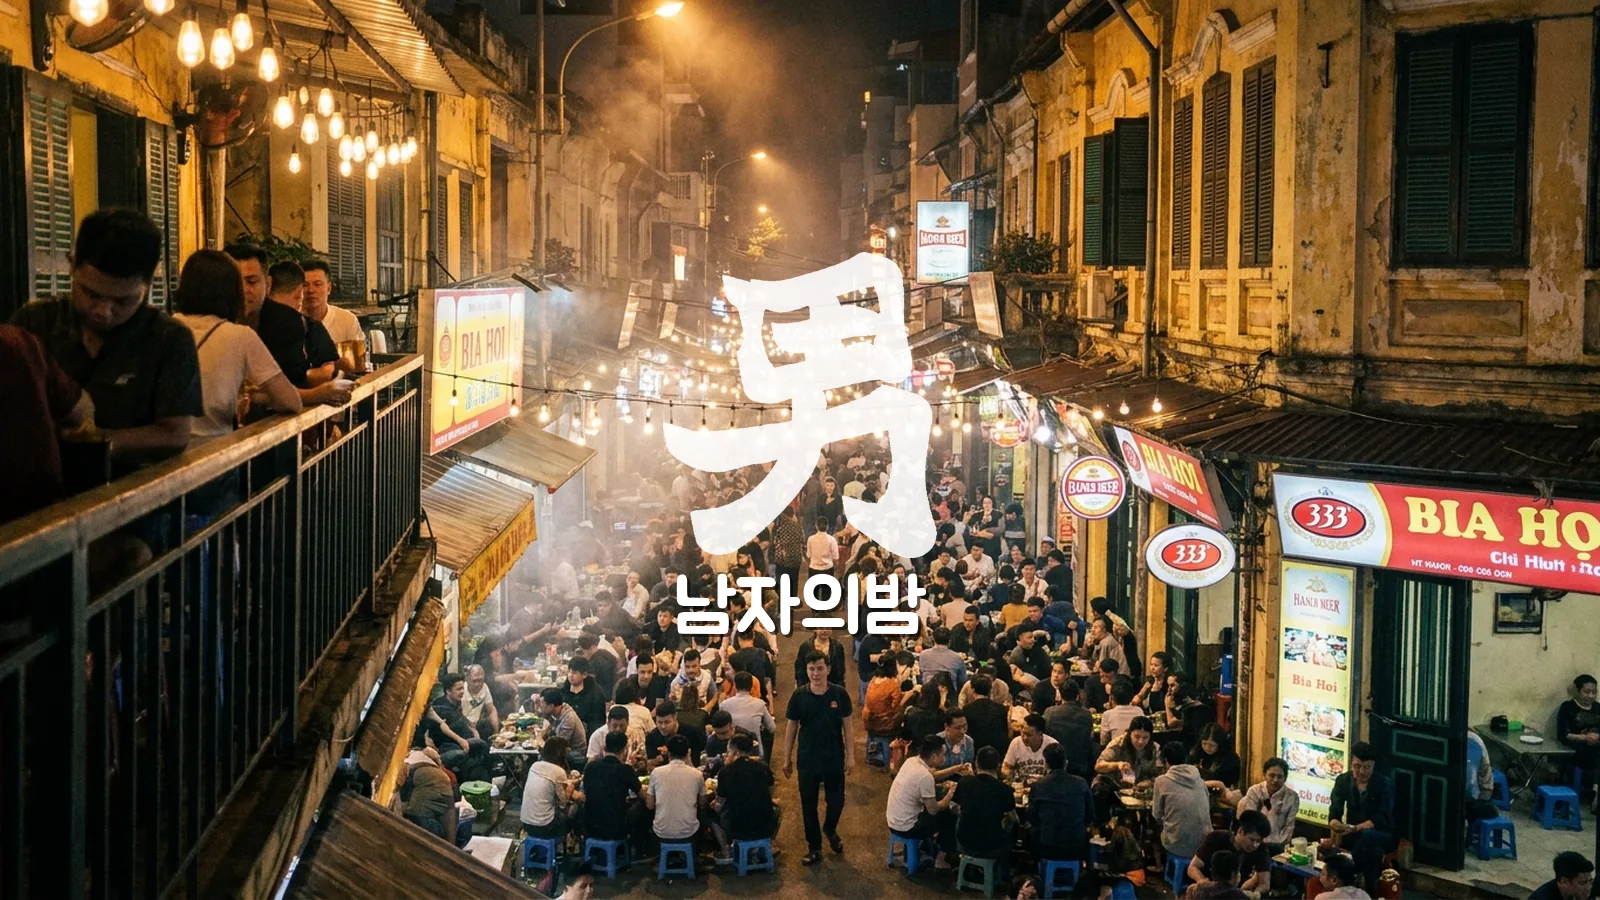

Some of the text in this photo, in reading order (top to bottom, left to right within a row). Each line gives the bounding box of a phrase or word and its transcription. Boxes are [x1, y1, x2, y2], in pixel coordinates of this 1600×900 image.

[486, 326, 505, 363] HOI
[1142, 443, 1172, 478] BIA
[1306, 503, 1348, 529] 333
[1404, 496, 1504, 542] BIA
[1172, 544, 1208, 564] 333
[1292, 674, 1338, 693] Bia Hoi
